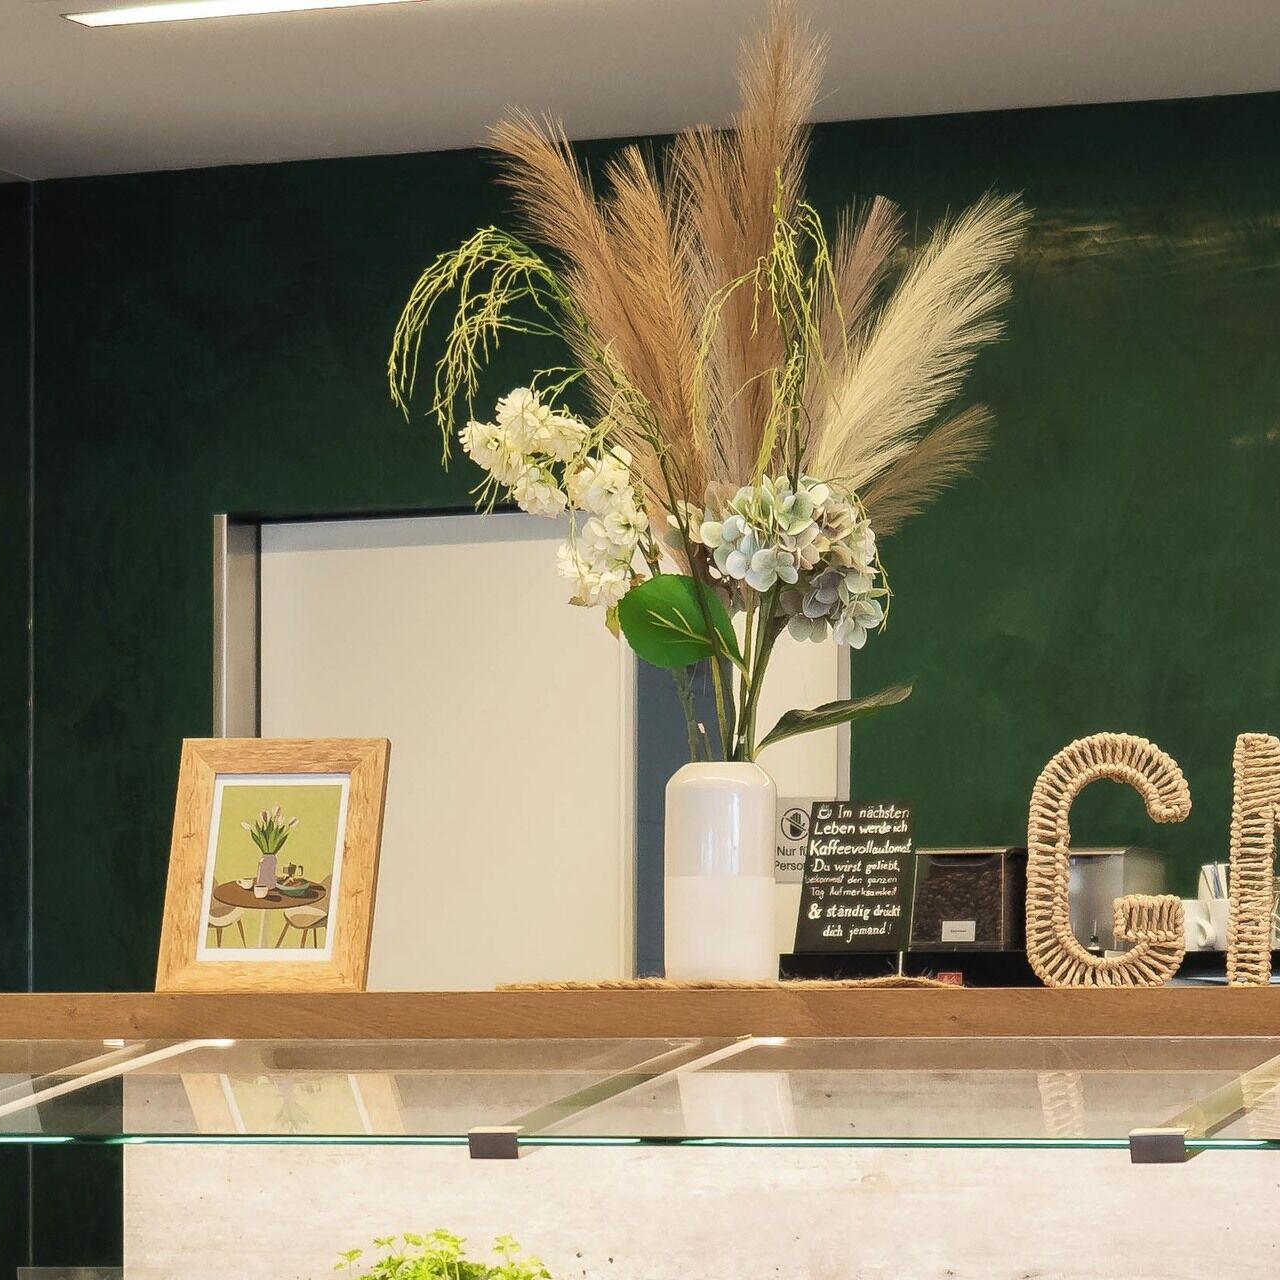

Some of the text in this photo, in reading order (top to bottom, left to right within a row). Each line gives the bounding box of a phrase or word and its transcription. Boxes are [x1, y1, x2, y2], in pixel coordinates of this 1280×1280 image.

[837, 804, 910, 819] Im nächsten
[814, 820, 908, 836] Leben werde ich
[776, 845, 797, 857] Nur
[809, 837, 912, 857] Kaffeevollautomat
[812, 858, 900, 875] Du wirst geliebt,
[847, 875, 863, 885] den
[867, 877, 898, 887] ganzen
[809, 886, 898, 900] Tag Aufmerksamkeit
[808, 903, 901, 920] & ständig drückt
[822, 921, 892, 944] dich jemand!
